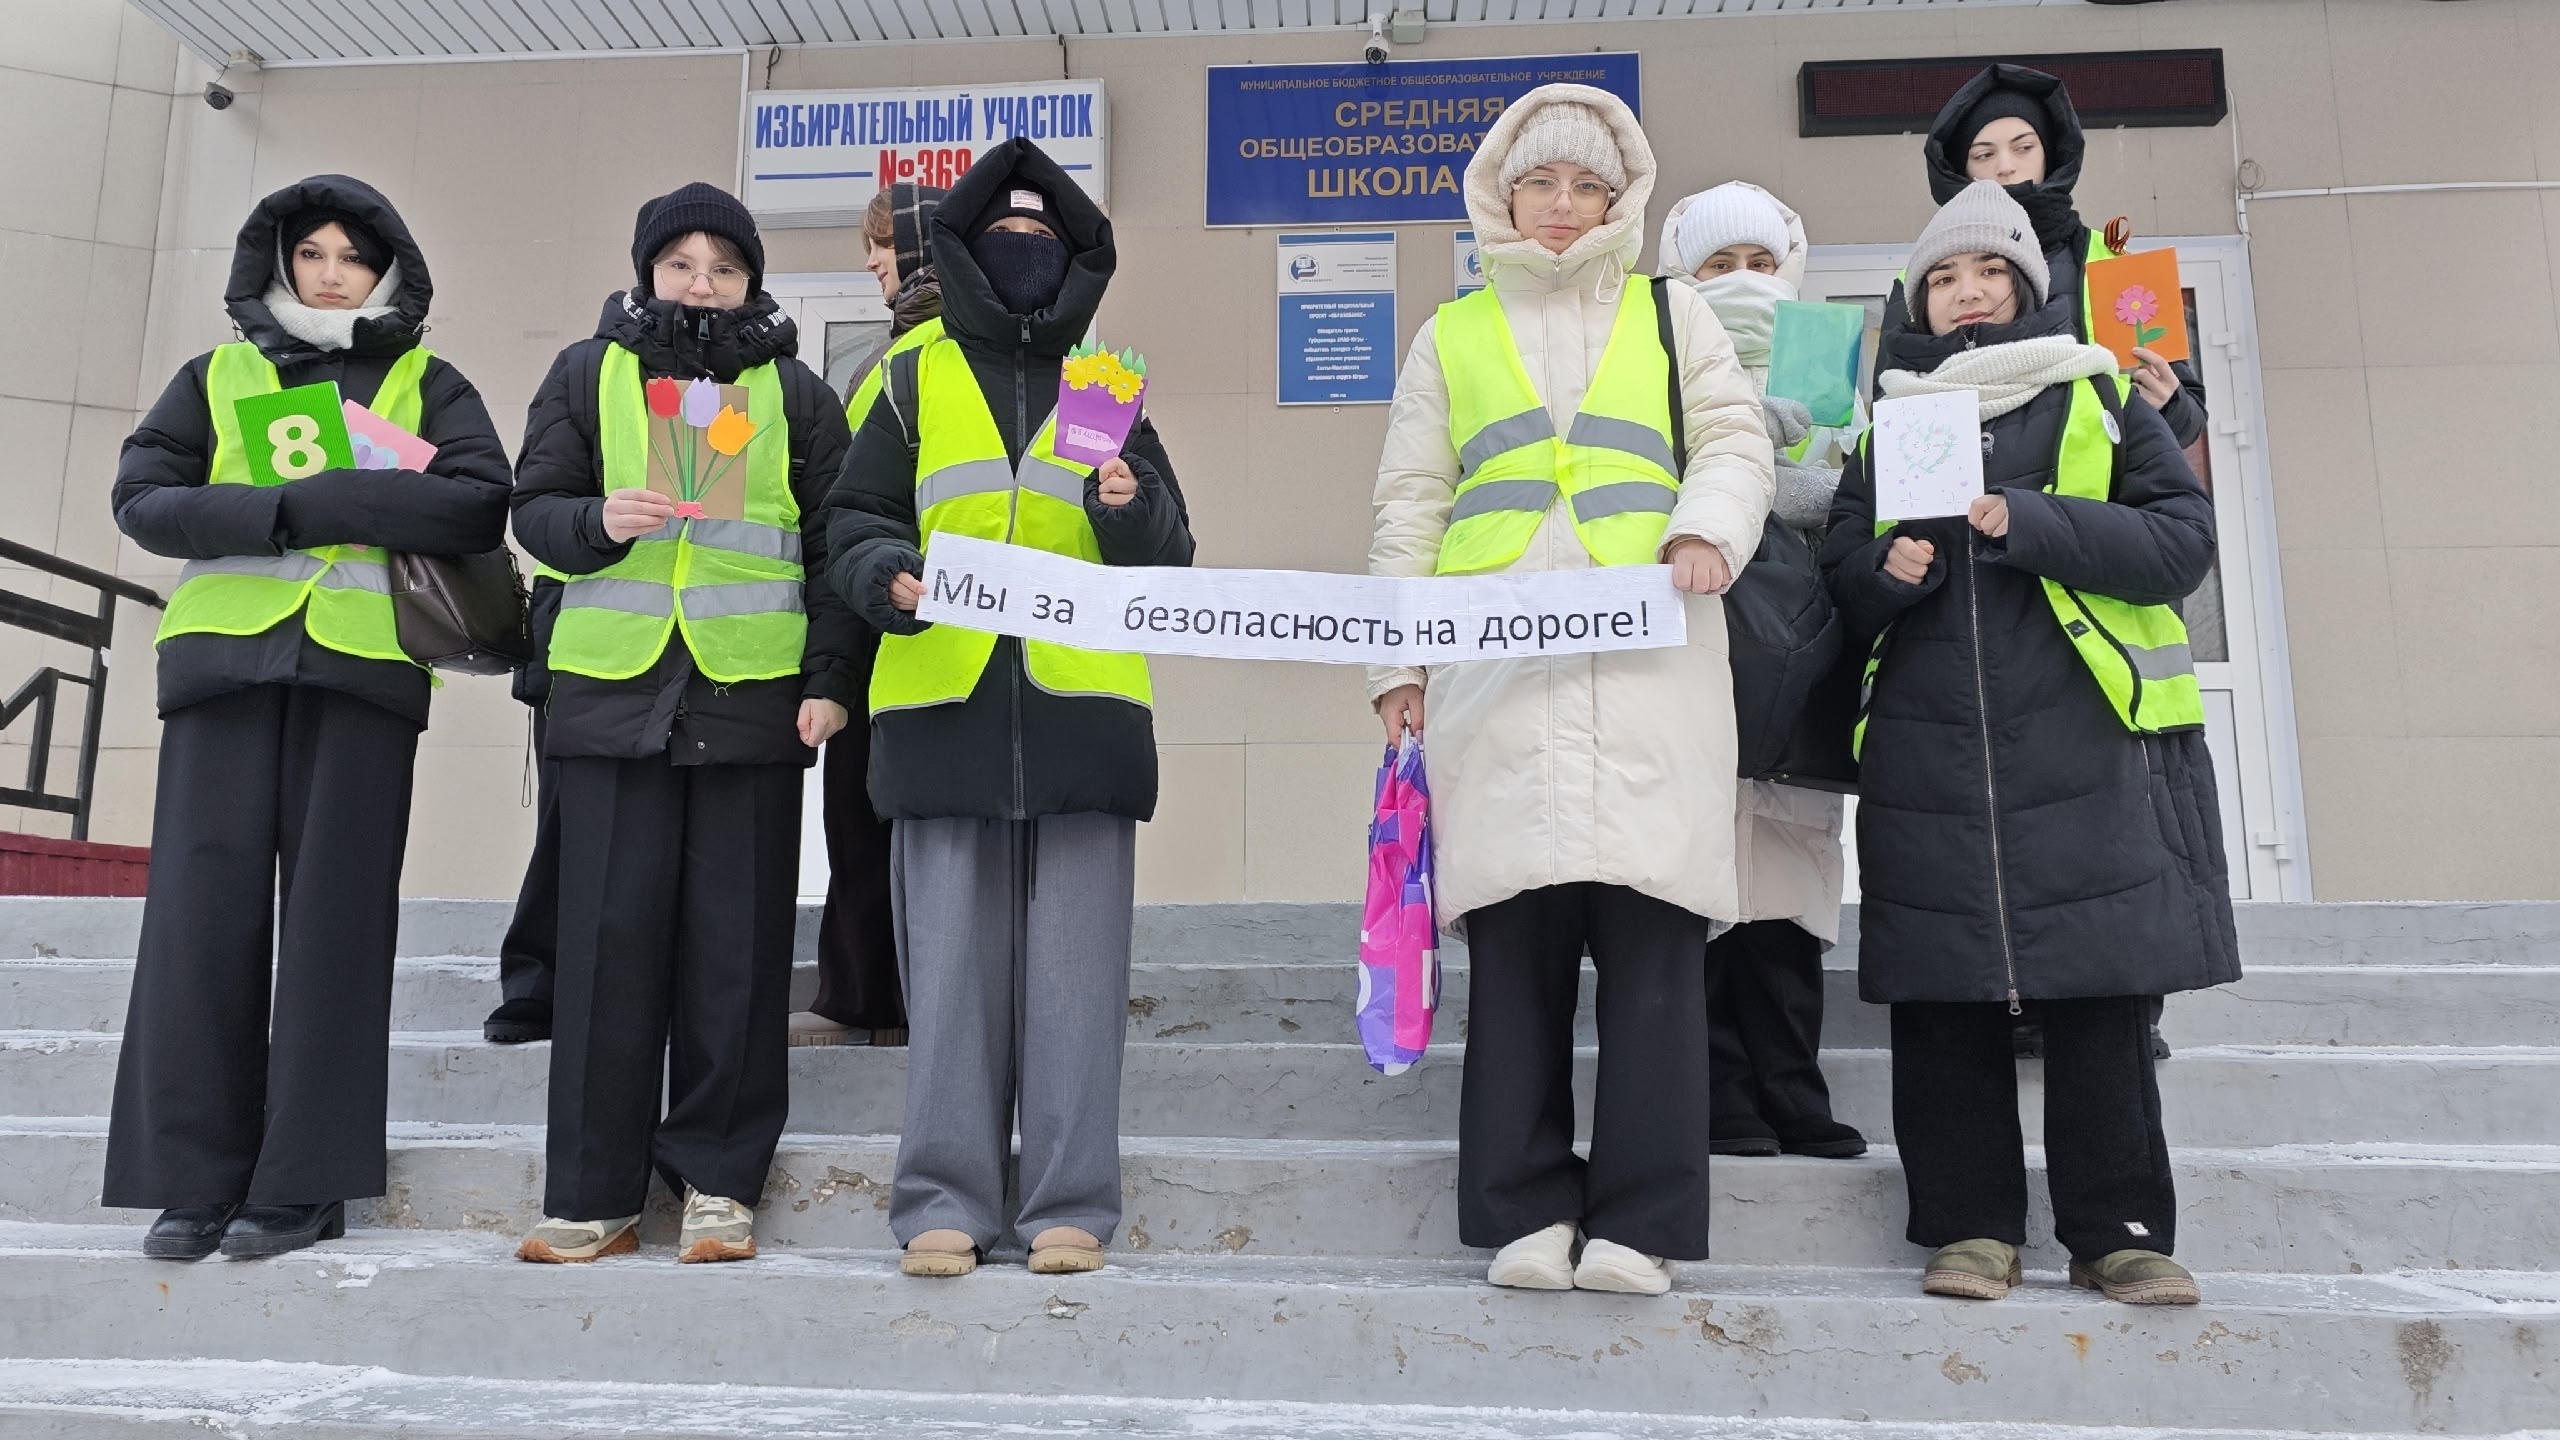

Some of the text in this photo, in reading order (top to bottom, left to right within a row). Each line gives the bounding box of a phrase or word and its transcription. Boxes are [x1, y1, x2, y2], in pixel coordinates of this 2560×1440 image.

[1240, 69, 1606, 91] МУНИЦИПАЛЬНОЕ БЮДЖЕТНОЕ ОБЩЕОБРАЗОВАТЕЛЬНОЕ УЧРЕЖДЕНИЕ
[755, 93, 1093, 148] ИЗБИРАТЕЛЬНЫЙ УЧАСТОК
[1335, 97, 1505, 130] СРЕДНЯЯ
[1308, 165, 1460, 198] ШКОЛА
[268, 414, 327, 480] 8
[932, 568, 1650, 650] Мы за безопасность на дороге!
